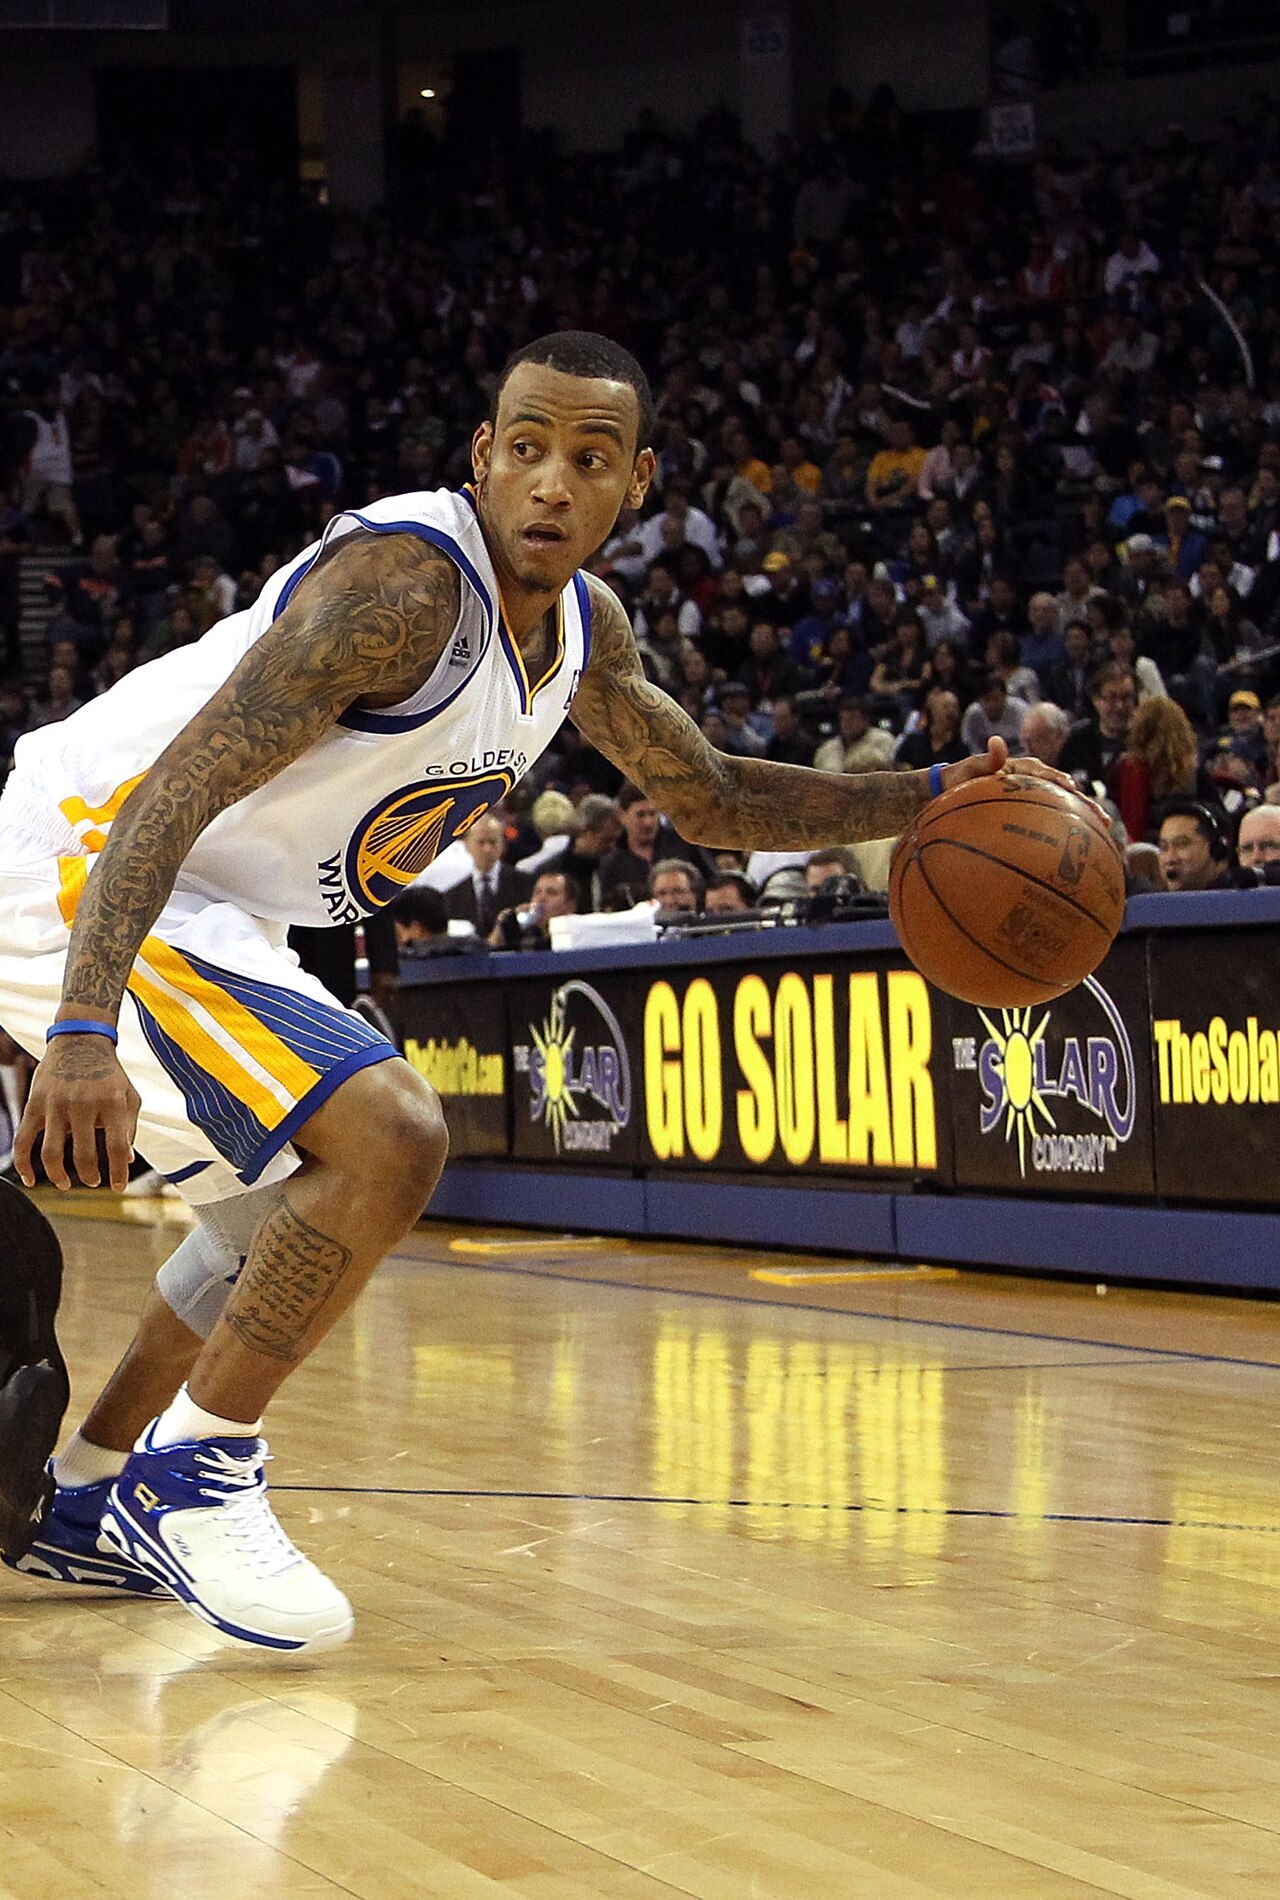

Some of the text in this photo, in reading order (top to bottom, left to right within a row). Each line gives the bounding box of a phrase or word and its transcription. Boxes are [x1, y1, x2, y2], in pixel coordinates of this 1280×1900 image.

[425, 749, 515, 776] GOLDE
[644, 970, 938, 1170] GO SOLAR
[952, 1037, 977, 1070] THE
[1153, 1015, 1280, 1105] TheSola
[978, 1037, 1135, 1142] SOLAR
[1031, 1133, 1106, 1173] COMPANY
